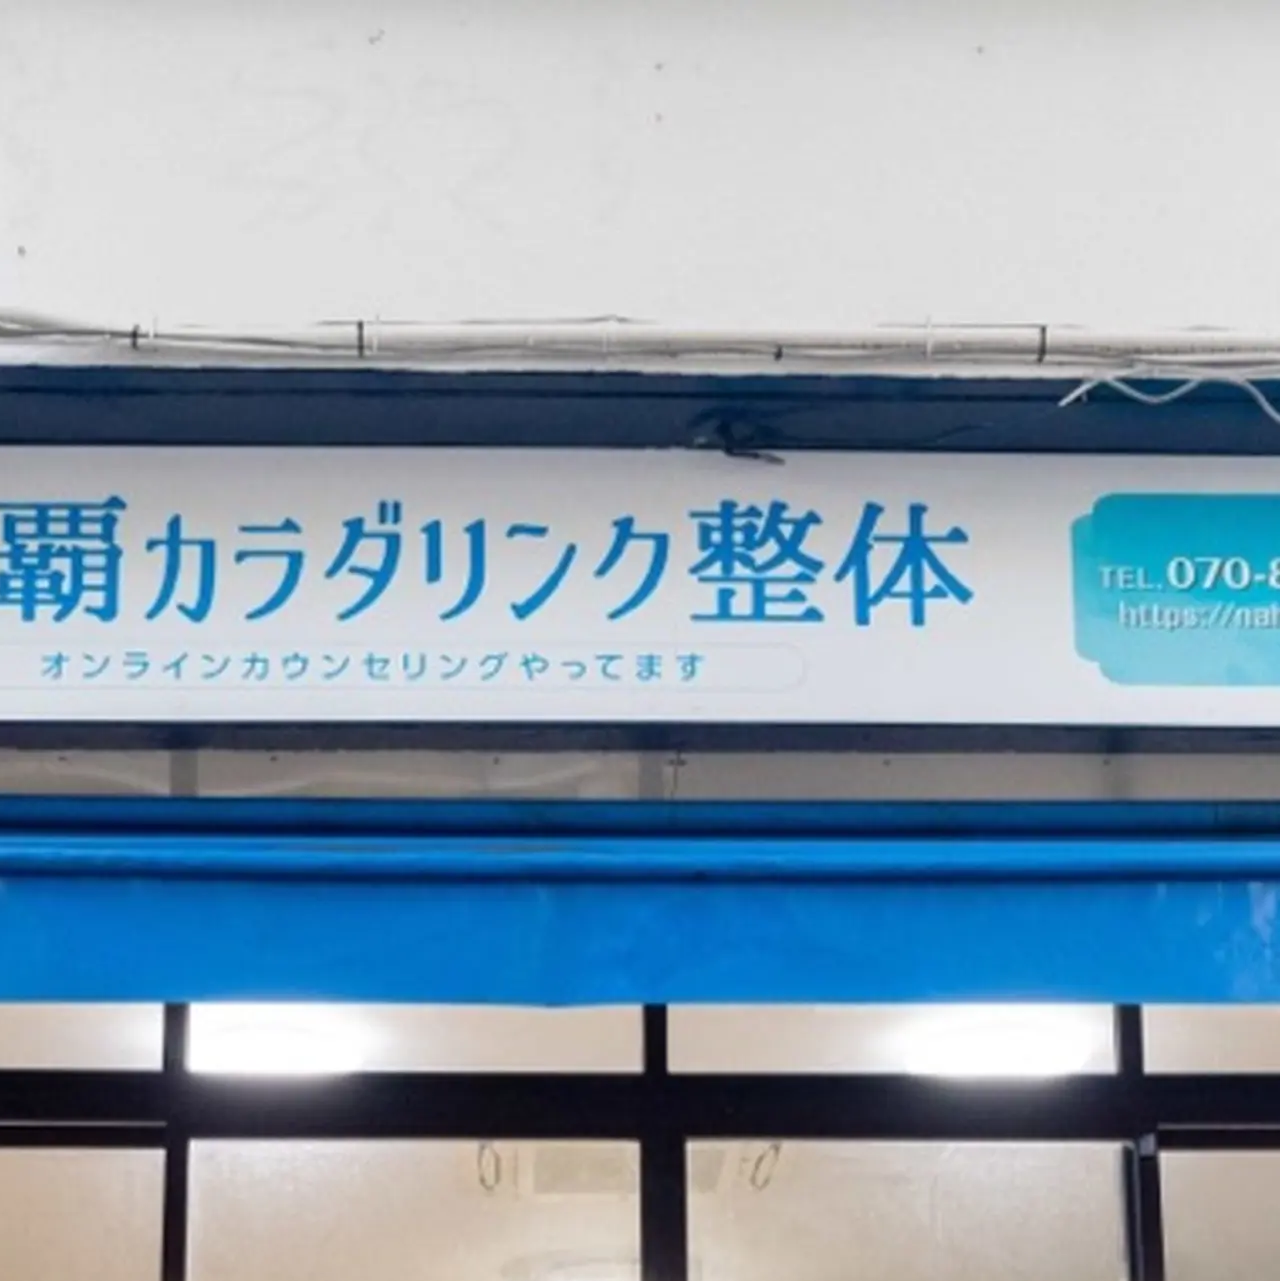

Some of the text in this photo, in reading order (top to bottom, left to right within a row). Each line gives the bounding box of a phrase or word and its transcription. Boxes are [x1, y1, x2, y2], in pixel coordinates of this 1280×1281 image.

[39, 651, 708, 683] オンラインカウンセリングやってます
